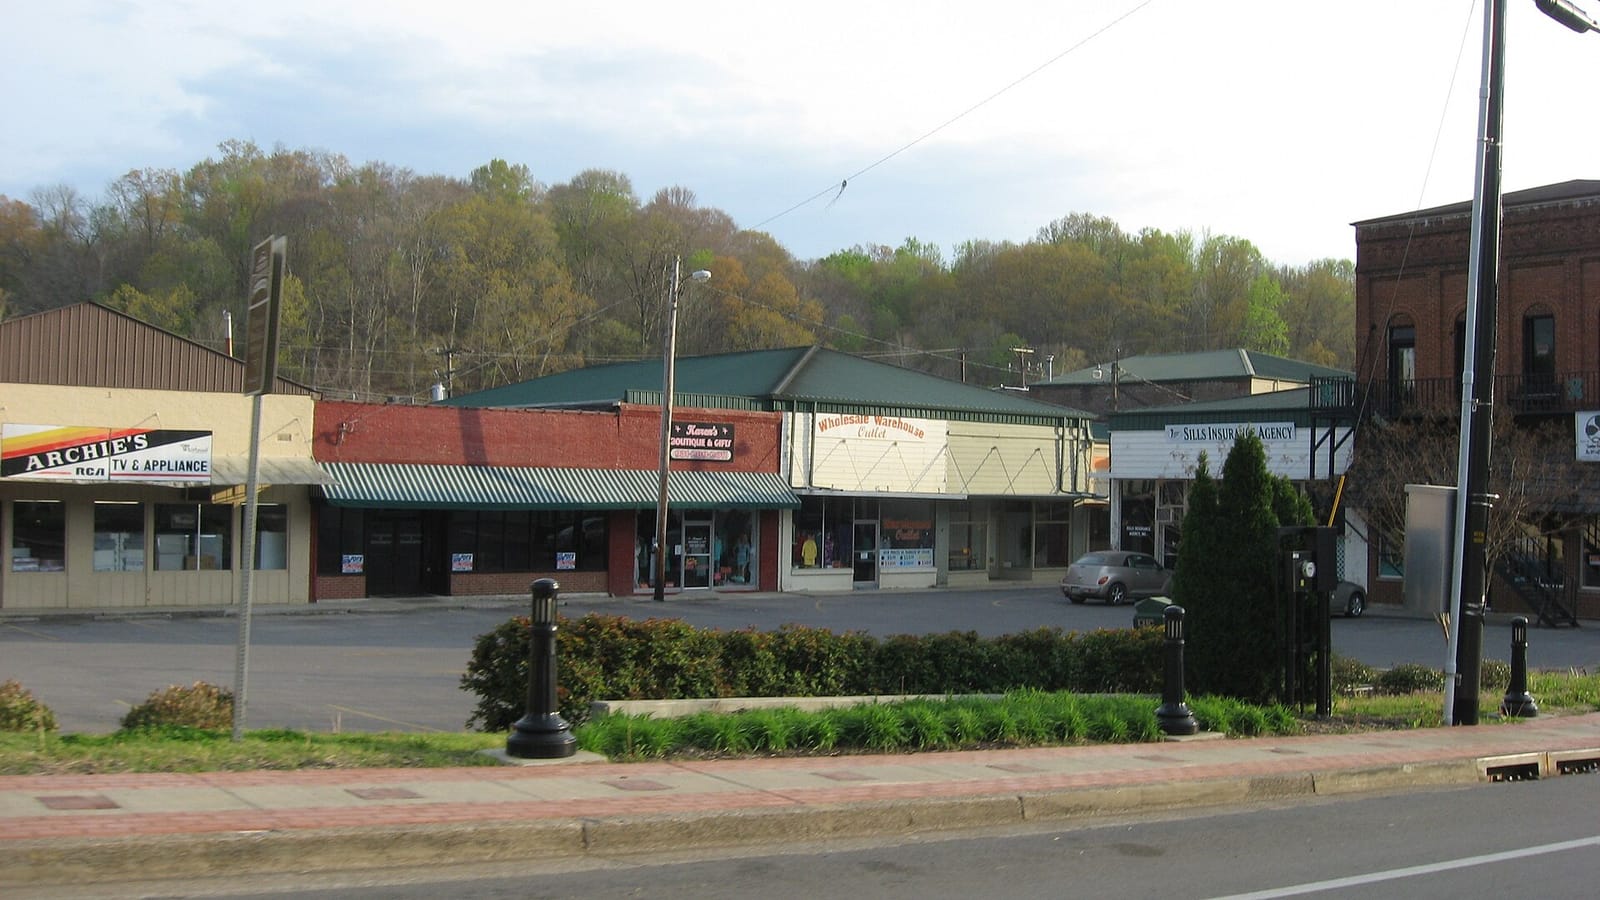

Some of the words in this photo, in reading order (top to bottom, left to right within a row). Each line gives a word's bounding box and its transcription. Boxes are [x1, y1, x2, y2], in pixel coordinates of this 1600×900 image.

[686, 424, 718, 437] Karen's
[818, 414, 869, 433] Wholesale
[874, 415, 925, 439] Warehouse
[857, 426, 887, 439] Outlet
[1183, 427, 1207, 440] SILLS
[1208, 426, 1256, 441] INSURANC
[1258, 425, 1293, 440] AGENCY
[671, 437, 706, 448] BOUTIQUE
[707, 439, 713, 447] &
[714, 439, 732, 448] GIFTS
[25, 433, 148, 472] ARCHIE'S
[75, 467, 105, 476] RCA
[112, 459, 127, 471] TV
[131, 460, 139, 471] &
[144, 459, 207, 472] APPLIANCE
